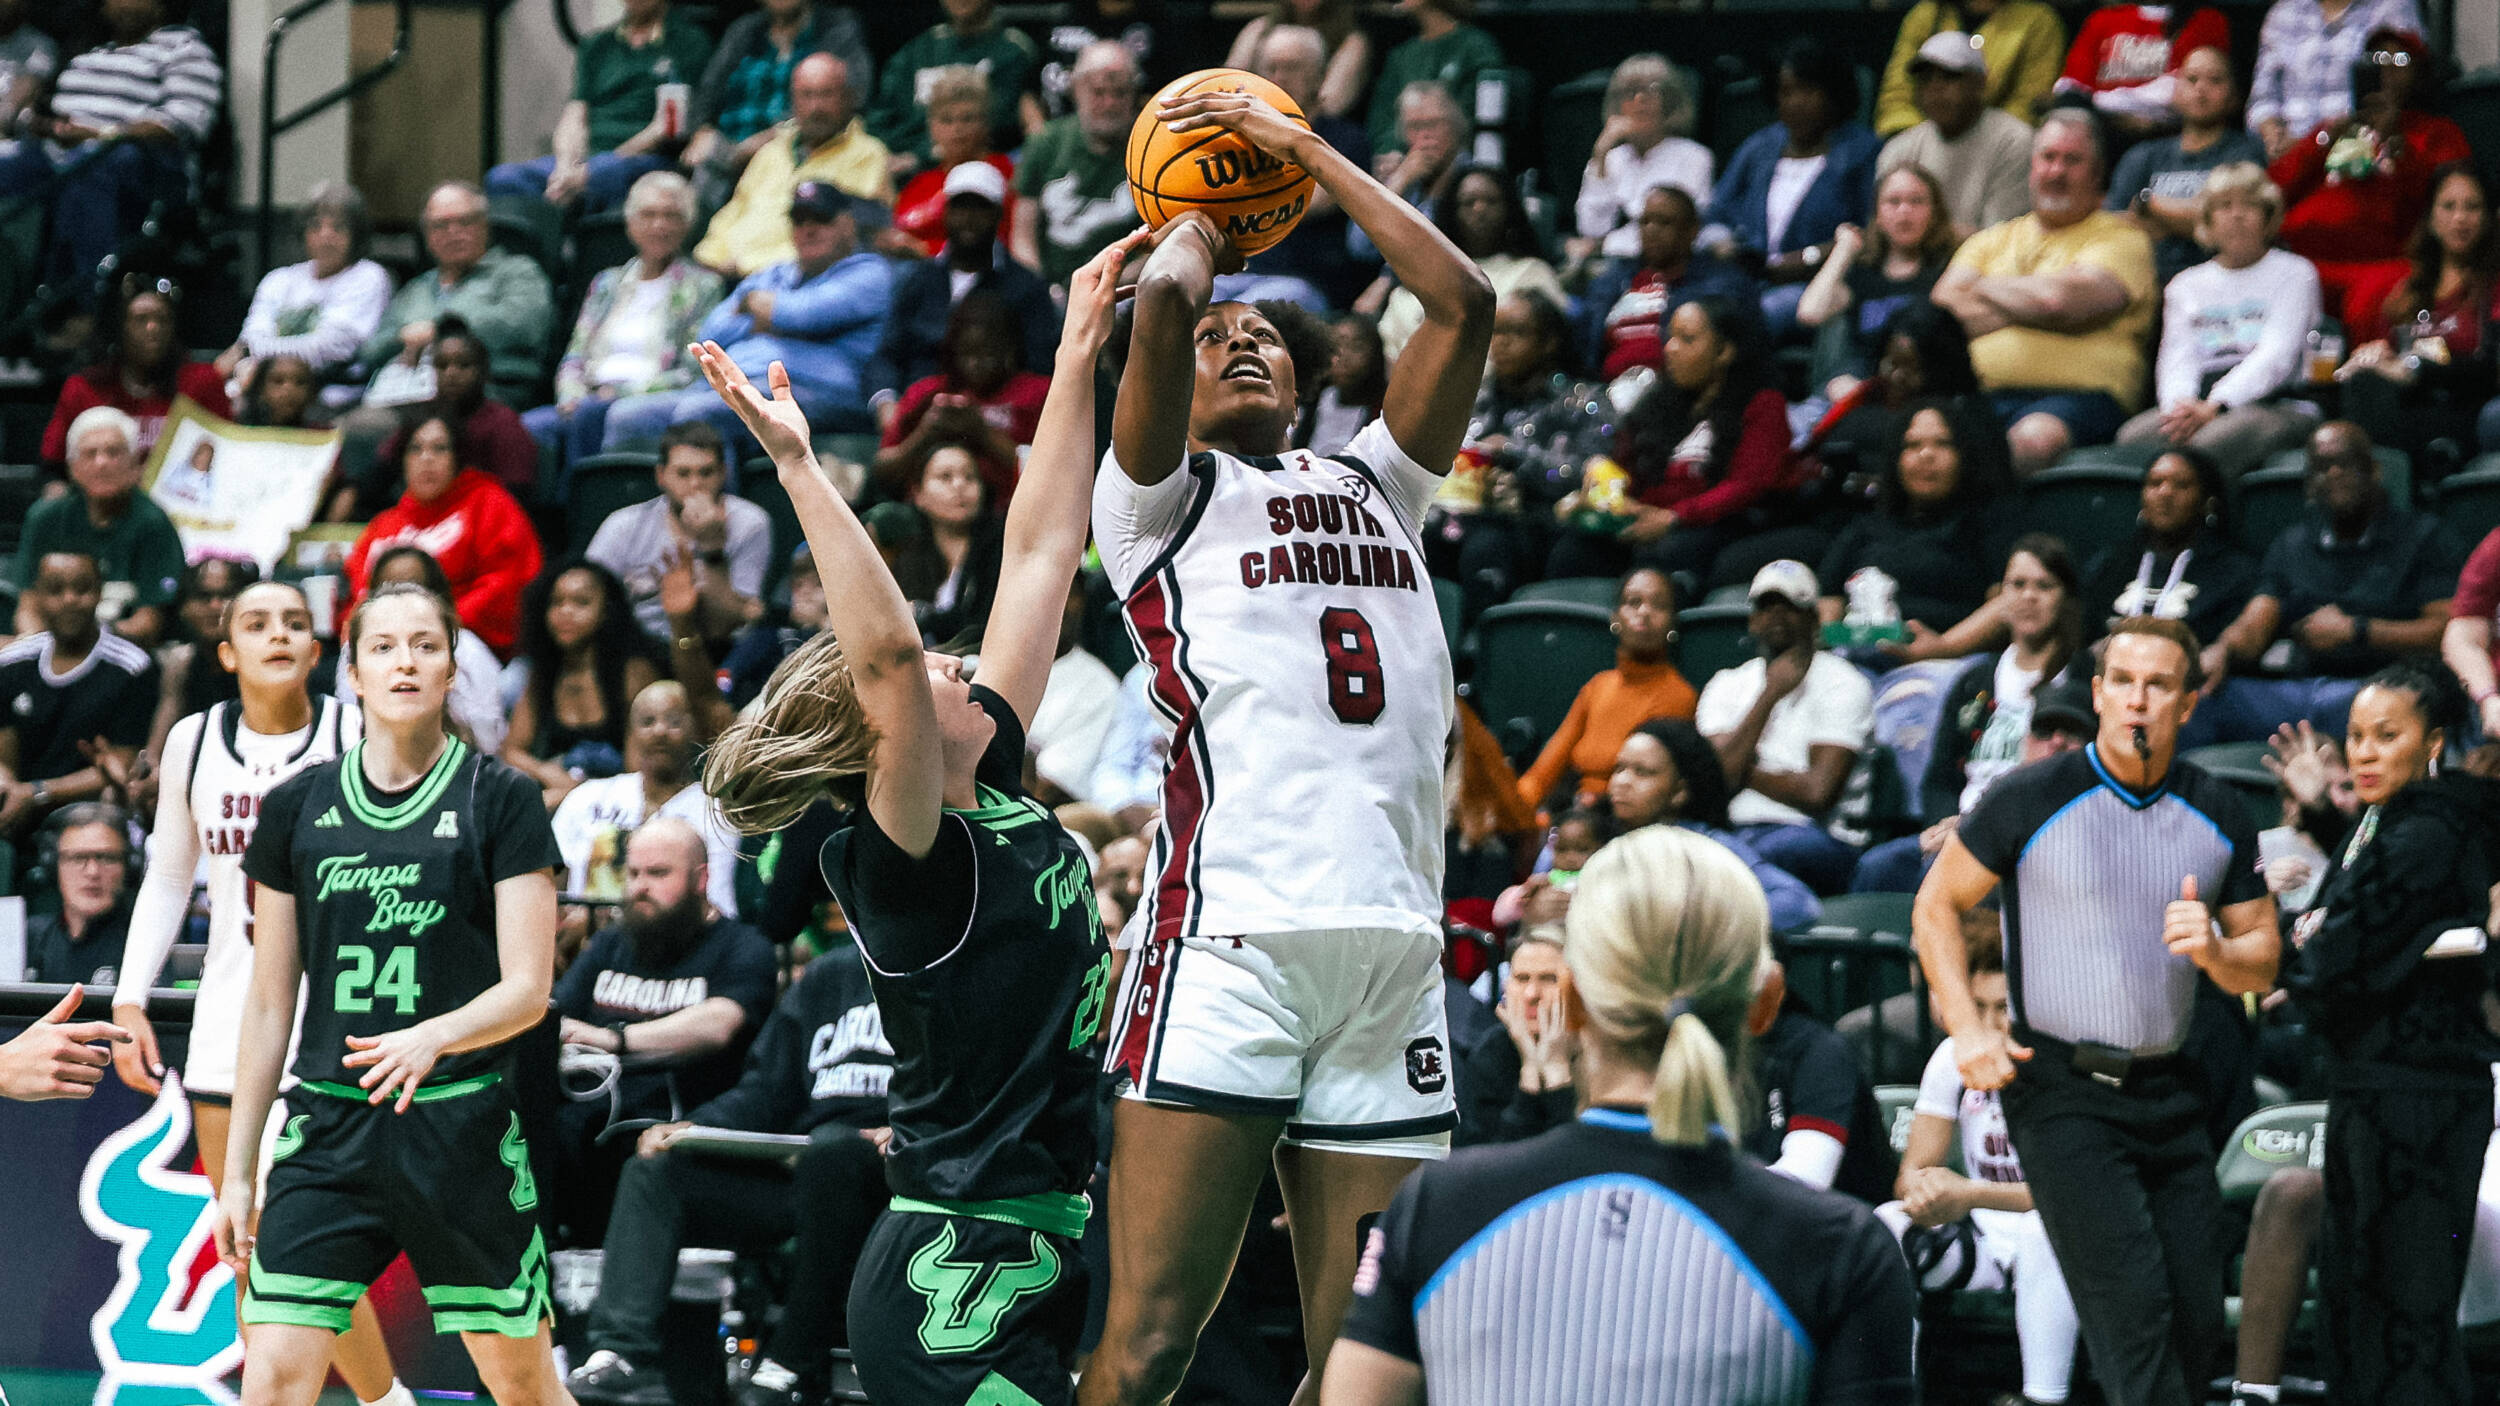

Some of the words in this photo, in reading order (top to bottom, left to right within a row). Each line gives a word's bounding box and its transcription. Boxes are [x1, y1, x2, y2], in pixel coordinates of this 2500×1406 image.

[1227, 193, 1305, 236] NCAA
[1266, 492, 1386, 538] SOUTH
[1239, 541, 1418, 592] CAROLINA
[1319, 605, 1386, 725] 8
[316, 852, 422, 902] Tampa
[365, 887, 448, 937] Bay
[334, 945, 423, 1015] 24
[593, 969, 708, 1015] CAROLINA
[1069, 952, 1111, 1050] 23
